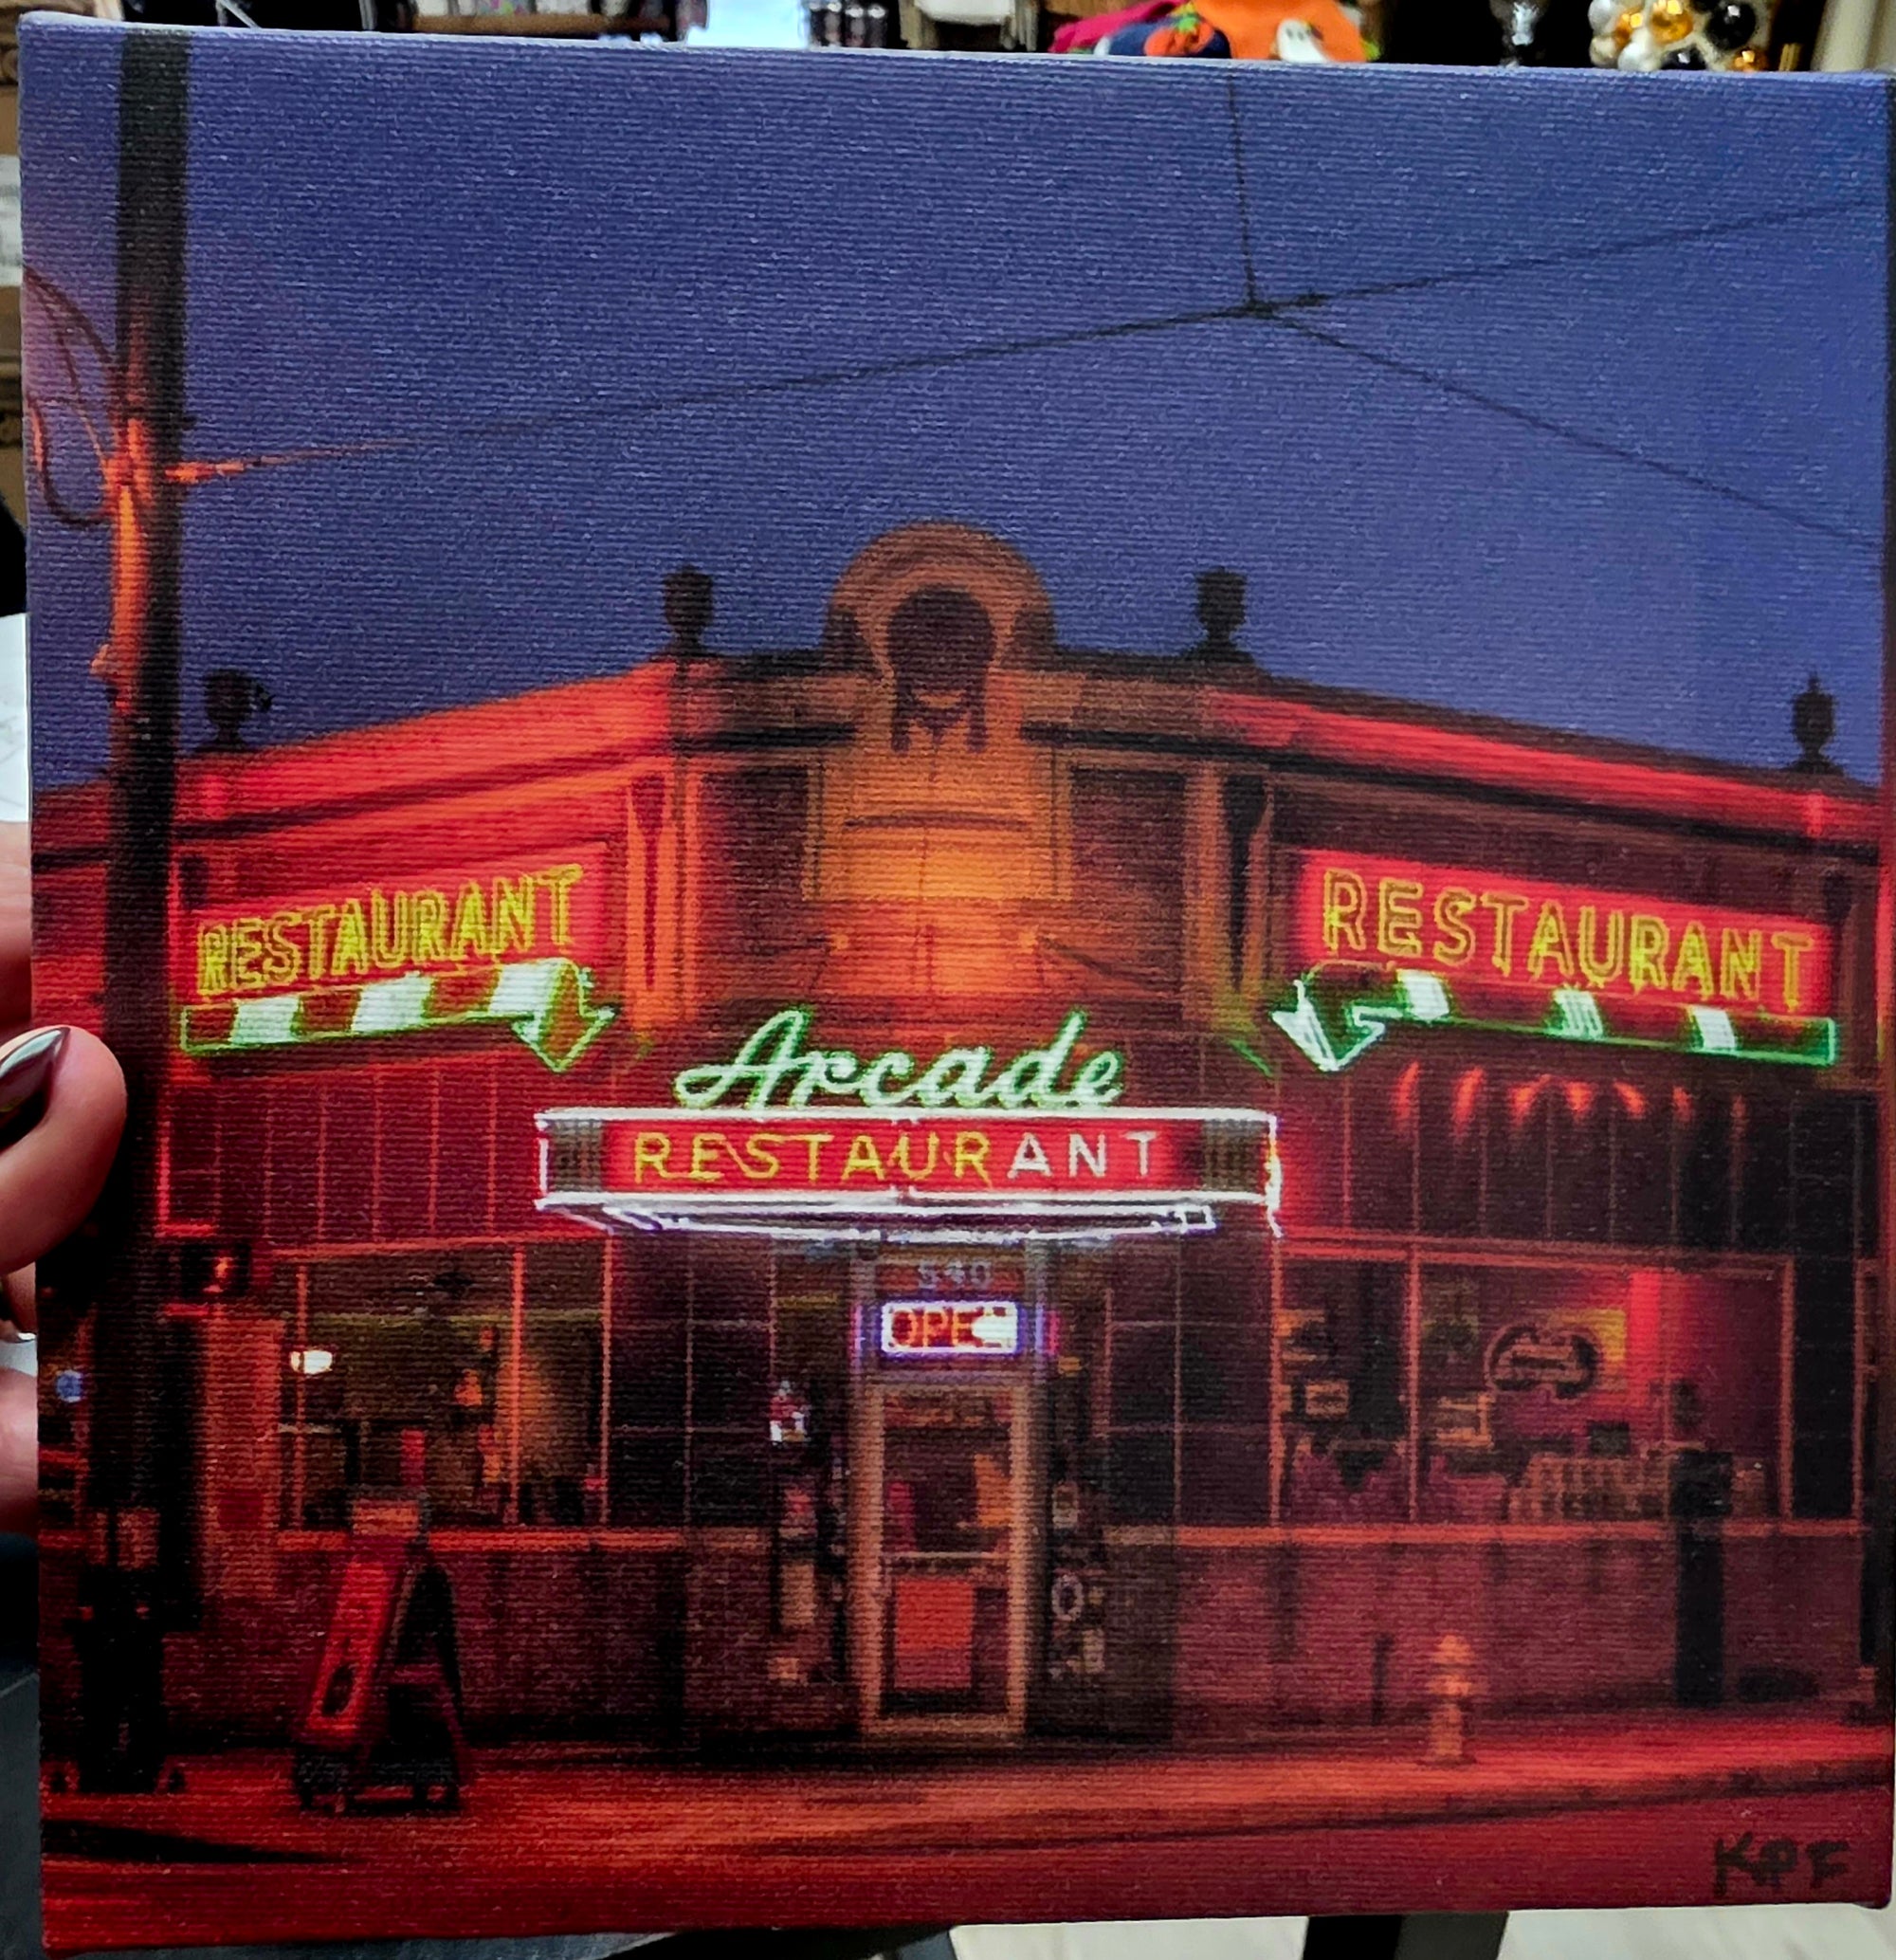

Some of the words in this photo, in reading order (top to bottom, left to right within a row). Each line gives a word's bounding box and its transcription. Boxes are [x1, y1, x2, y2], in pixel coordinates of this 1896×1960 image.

[196, 863, 583, 996] RESTAURANT
[1323, 868, 1814, 1012] RESTAURANT
[674, 1005, 1124, 1109] Arcade
[633, 1131, 1158, 1187] RESTAURANT
[890, 1305, 1014, 1347] OPE
